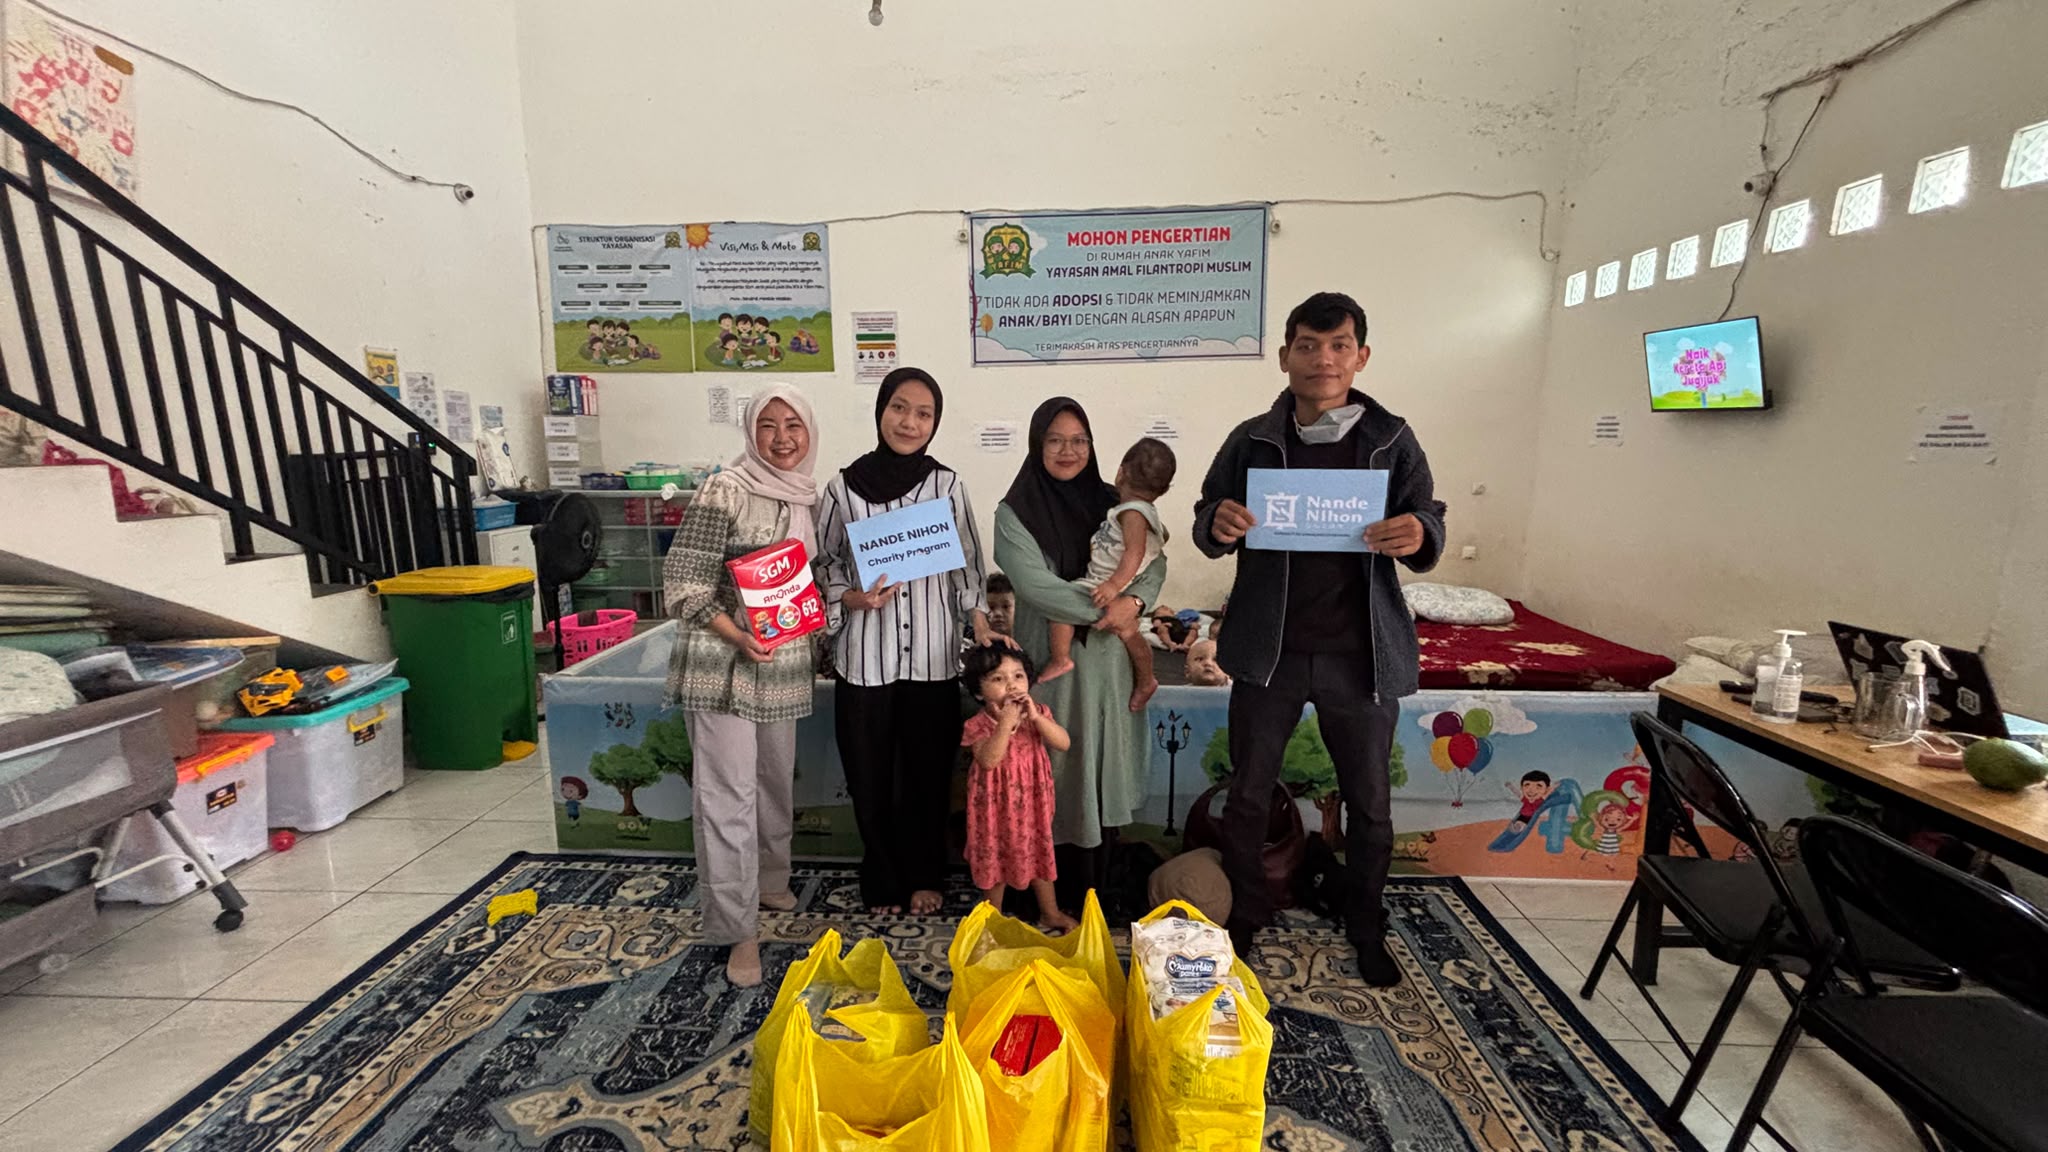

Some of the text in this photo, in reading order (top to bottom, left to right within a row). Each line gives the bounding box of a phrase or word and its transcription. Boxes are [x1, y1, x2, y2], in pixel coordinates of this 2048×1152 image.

[614, 235, 656, 243] ORGANISASI
[1067, 226, 1231, 247] MOHON PENGERTIAN
[772, 241, 797, 251] Moto
[1086, 248, 1211, 261] DI RUMAH ANAK YAFIM
[1046, 260, 1252, 278] YAYASAN AMAL FILANTROPI MUSLIM
[984, 288, 1251, 309] TIDAK ADA ADOPSI & TIDAK MEMINJAMKAN
[998, 308, 1236, 328] ANAK/BAYI DENGAN ALASAN APAPUN
[1035, 339, 1200, 352] TERIMAKASIH ATAS PENGERTIANNYA
[1684, 347, 1710, 360] Naik
[1306, 495, 1369, 510] Nande
[1305, 509, 1364, 523] Nihon
[859, 521, 951, 553] NANDE NIHON
[867, 551, 905, 568] Charity
[758, 556, 791, 584] SGM
[801, 597, 820, 617] 612
